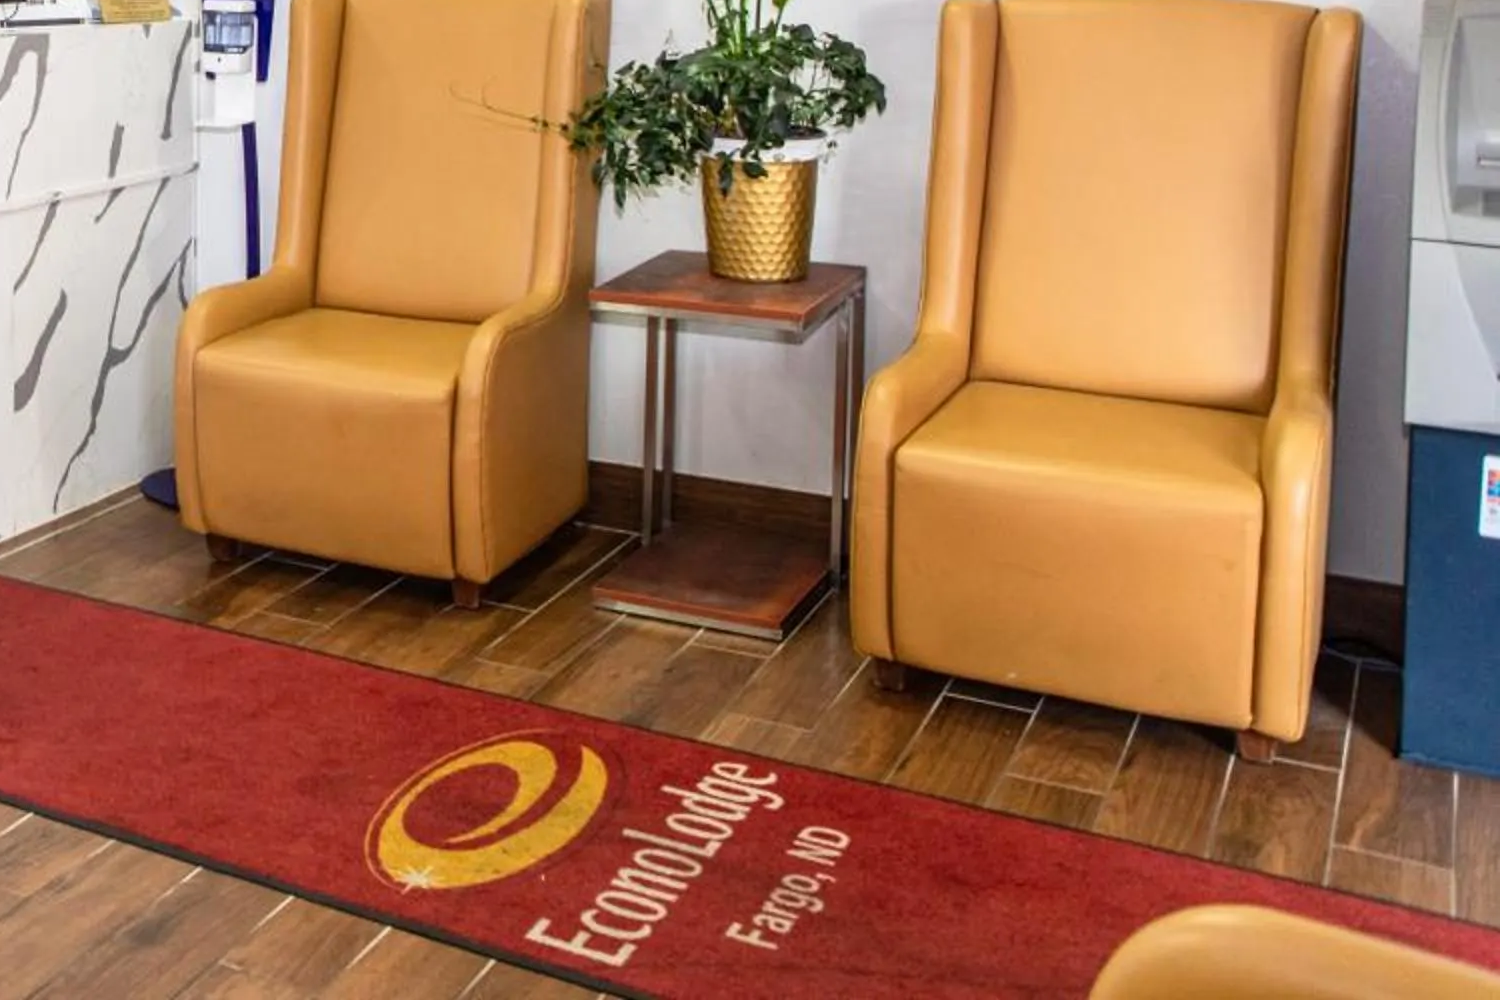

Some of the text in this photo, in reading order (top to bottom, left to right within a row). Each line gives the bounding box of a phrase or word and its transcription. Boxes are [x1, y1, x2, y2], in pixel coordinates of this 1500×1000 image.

[524, 761, 785, 967] EconoLodge
[725, 825, 850, 950] Fargo, ND
